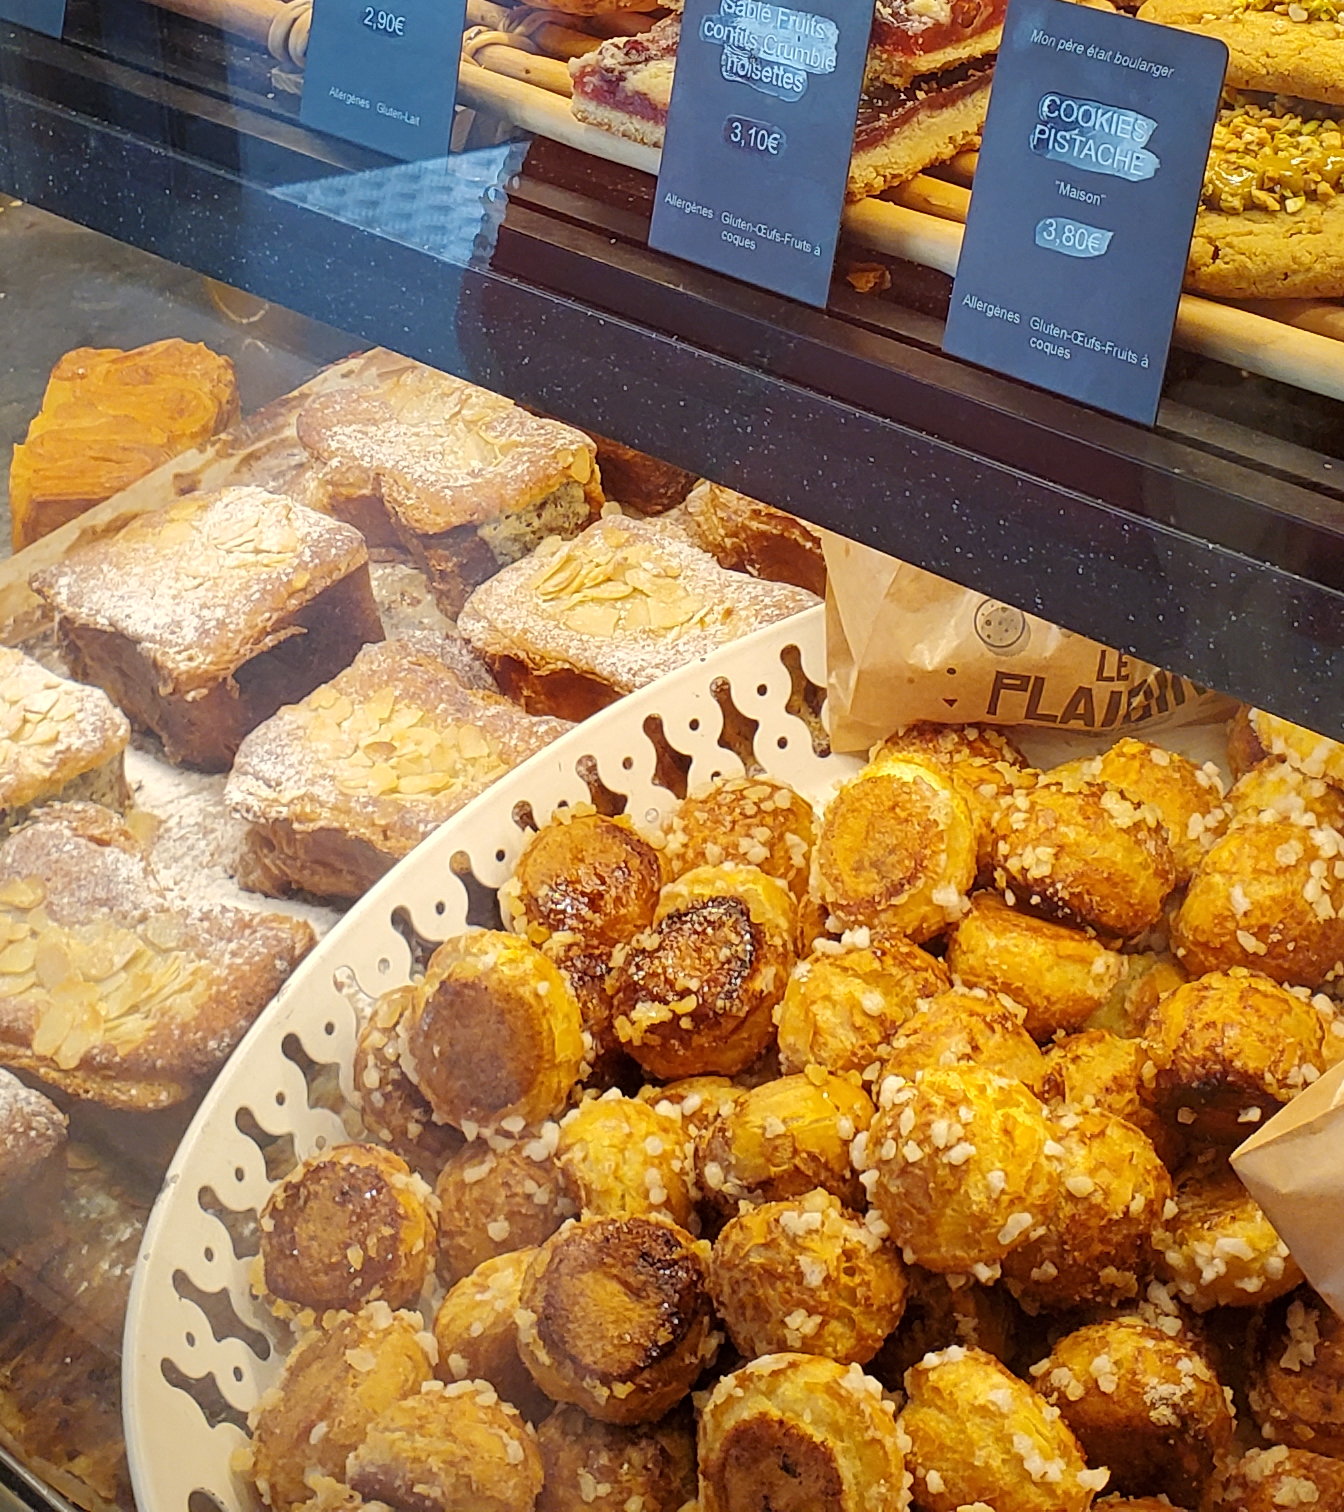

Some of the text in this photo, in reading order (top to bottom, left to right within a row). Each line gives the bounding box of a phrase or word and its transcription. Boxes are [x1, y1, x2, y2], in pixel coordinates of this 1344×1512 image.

[363, 6, 406, 36] 2,90€
[777, 7, 827, 37] Fruits
[704, 21, 836, 72] confits Crumble
[1030, 29, 1175, 79] Mon père était boulanger
[727, 55, 804, 93] noisettes
[1042, 96, 1148, 143] COOKIES
[730, 121, 781, 155] 3,10€
[1033, 124, 1148, 176] PISTACHE
[721, 230, 757, 251] coques
[1042, 218, 1104, 255] 3,80€
[1029, 337, 1072, 361] coques
[1140, 354, 1150, 369] à
[1096, 650, 1130, 682] LE
